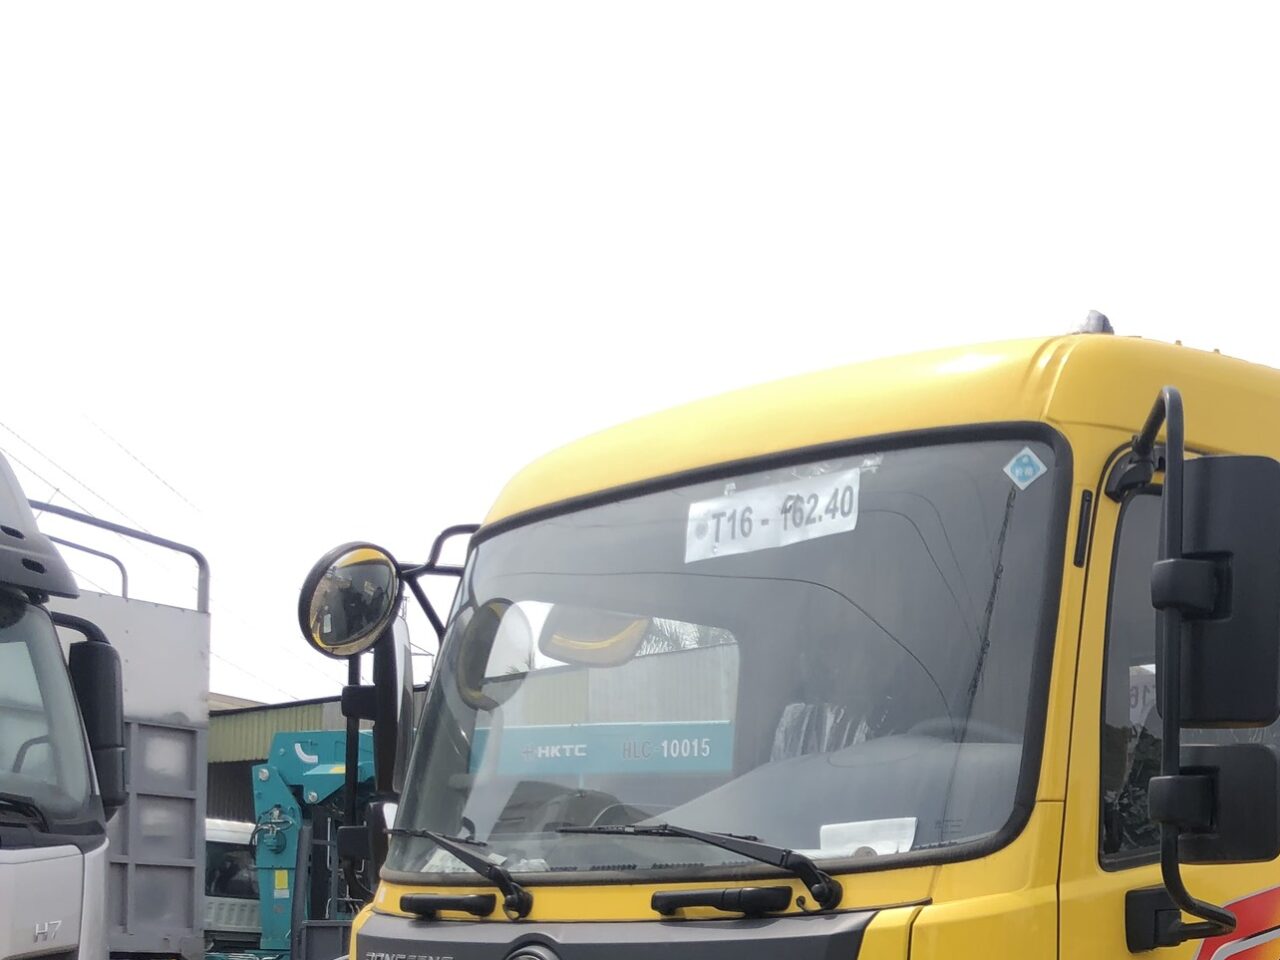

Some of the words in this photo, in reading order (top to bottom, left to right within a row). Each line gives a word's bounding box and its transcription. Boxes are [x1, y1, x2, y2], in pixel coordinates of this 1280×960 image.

[712, 506, 754, 543] T16
[537, 744, 588, 758] HKTC
[33, 920, 62, 943] H7
